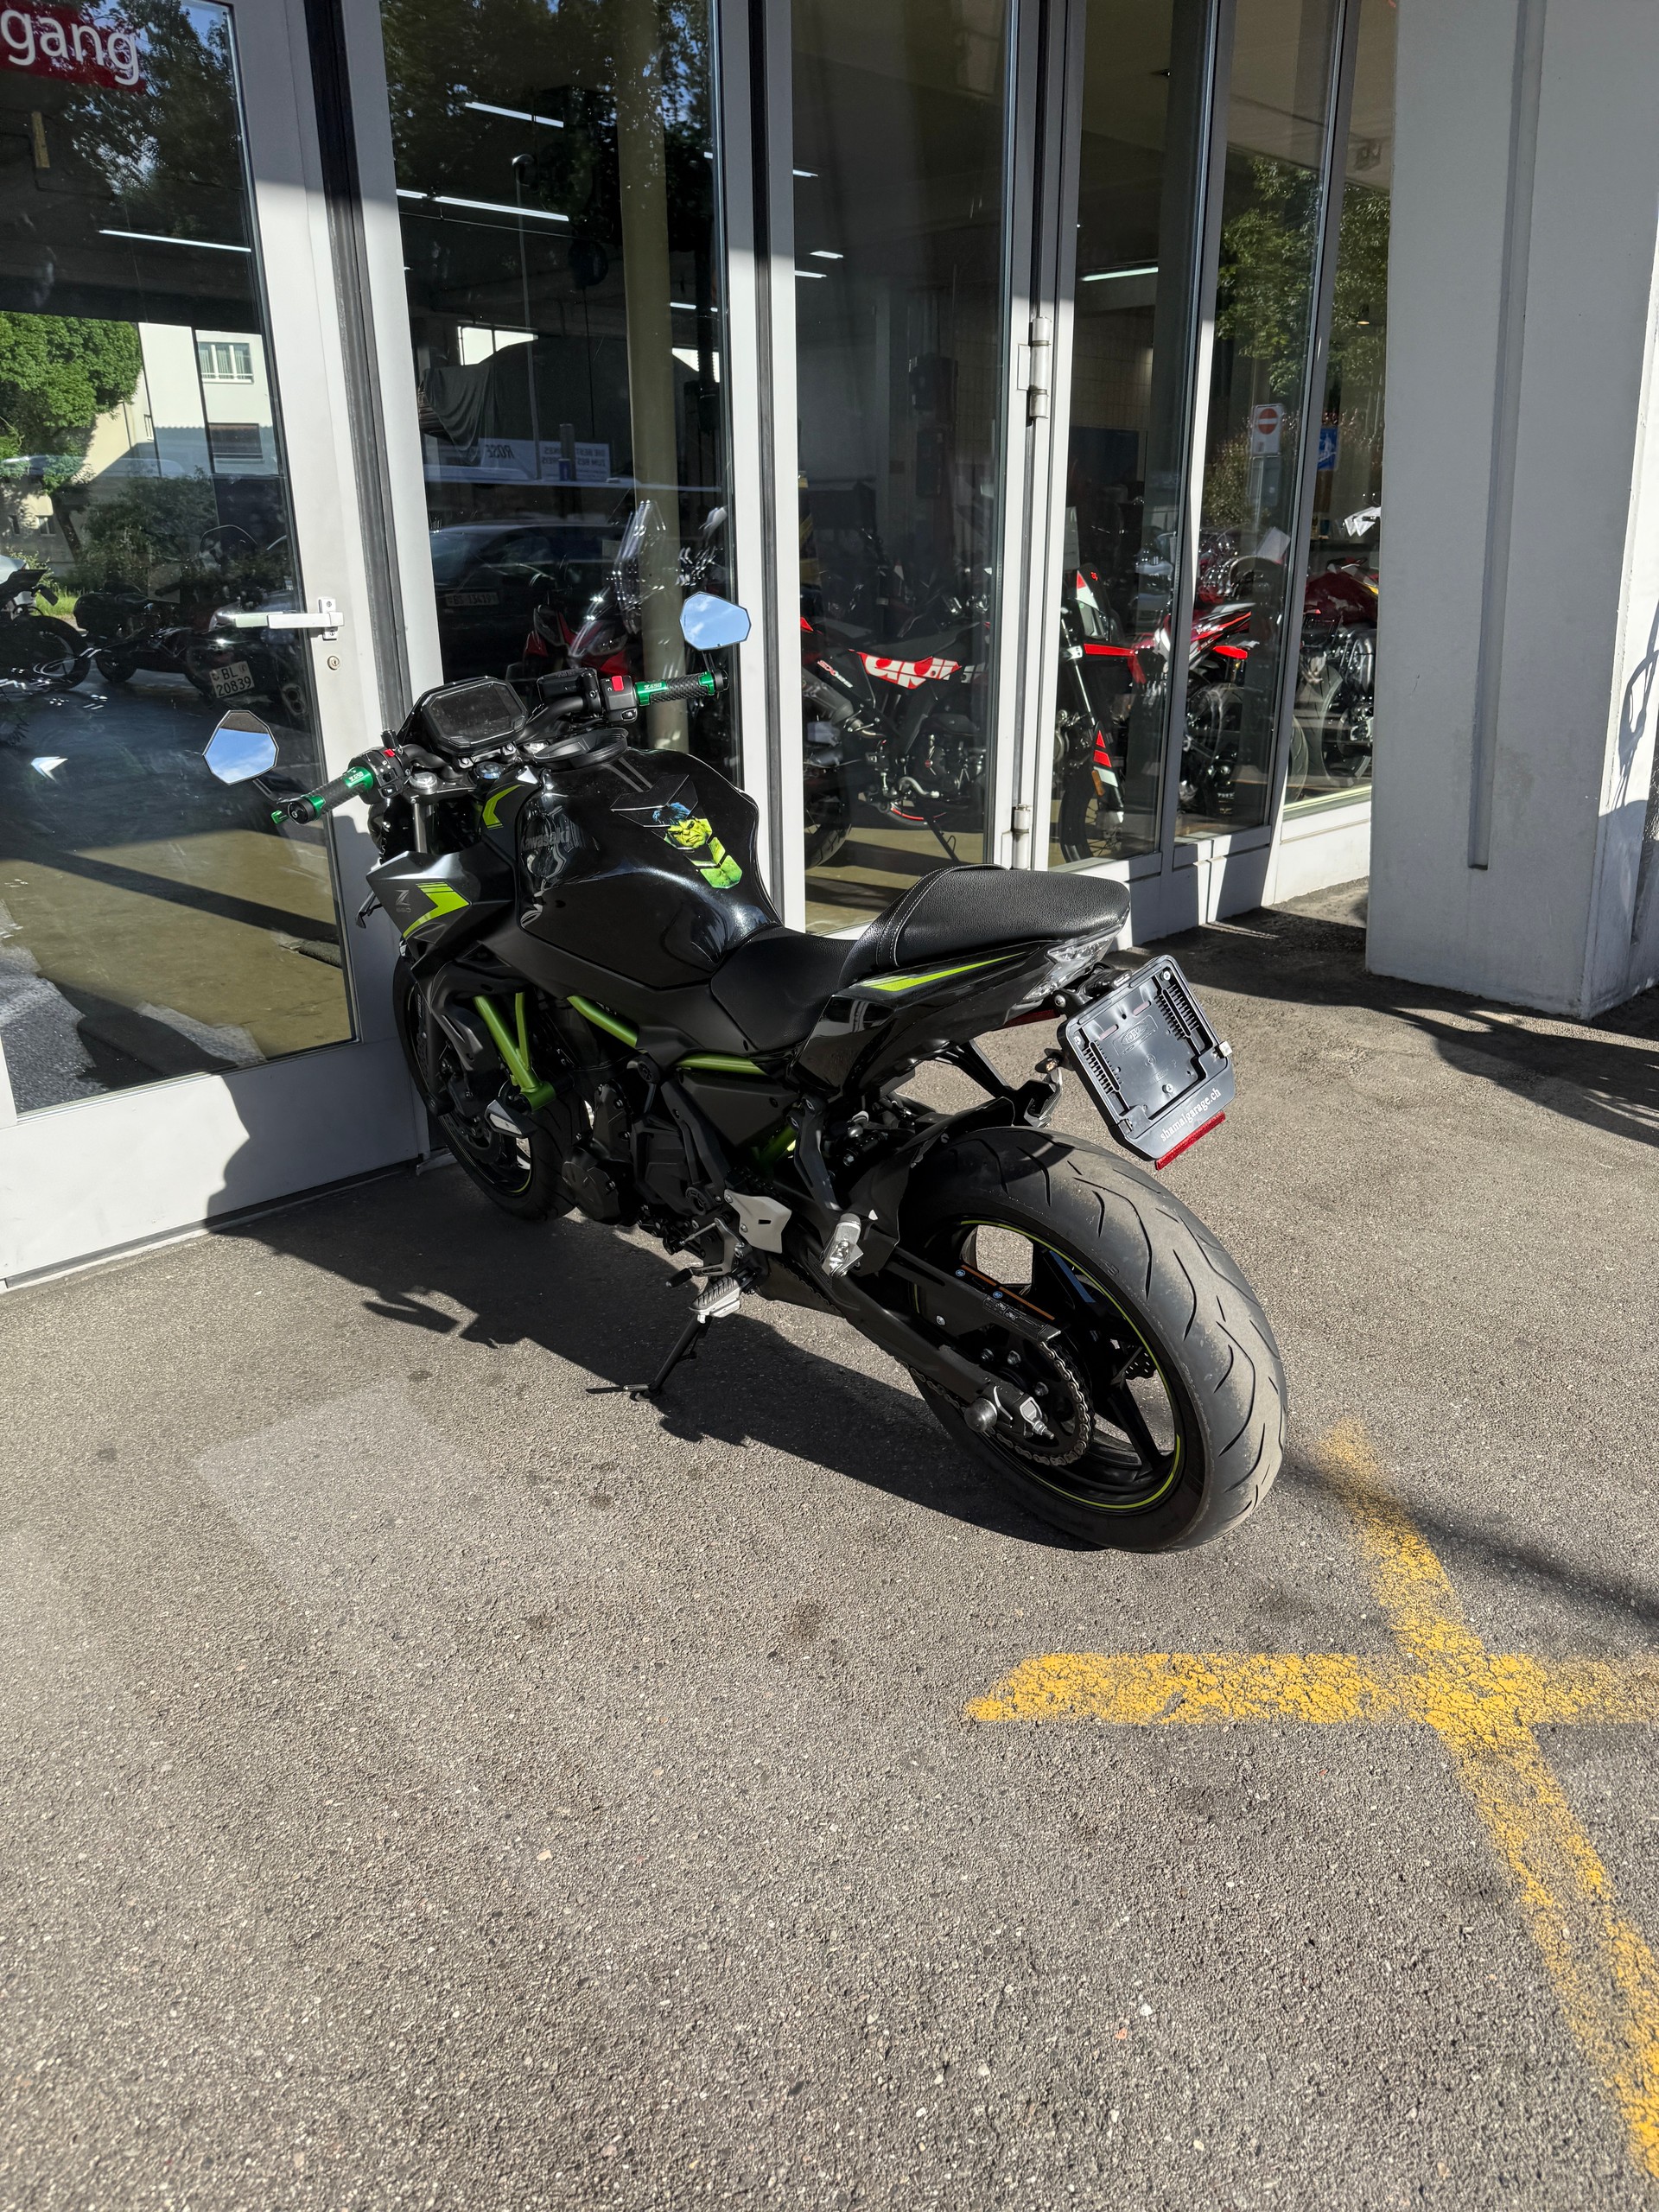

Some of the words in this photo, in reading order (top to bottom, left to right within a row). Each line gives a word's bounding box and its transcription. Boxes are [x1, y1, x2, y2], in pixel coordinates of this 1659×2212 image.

[1, 10, 139, 86] gang
[221, 666, 238, 680] BL
[216, 676, 252, 696] 20839
[395, 889, 411, 906] Z
[1160, 1087, 1222, 1141] shamalgarage.ch
